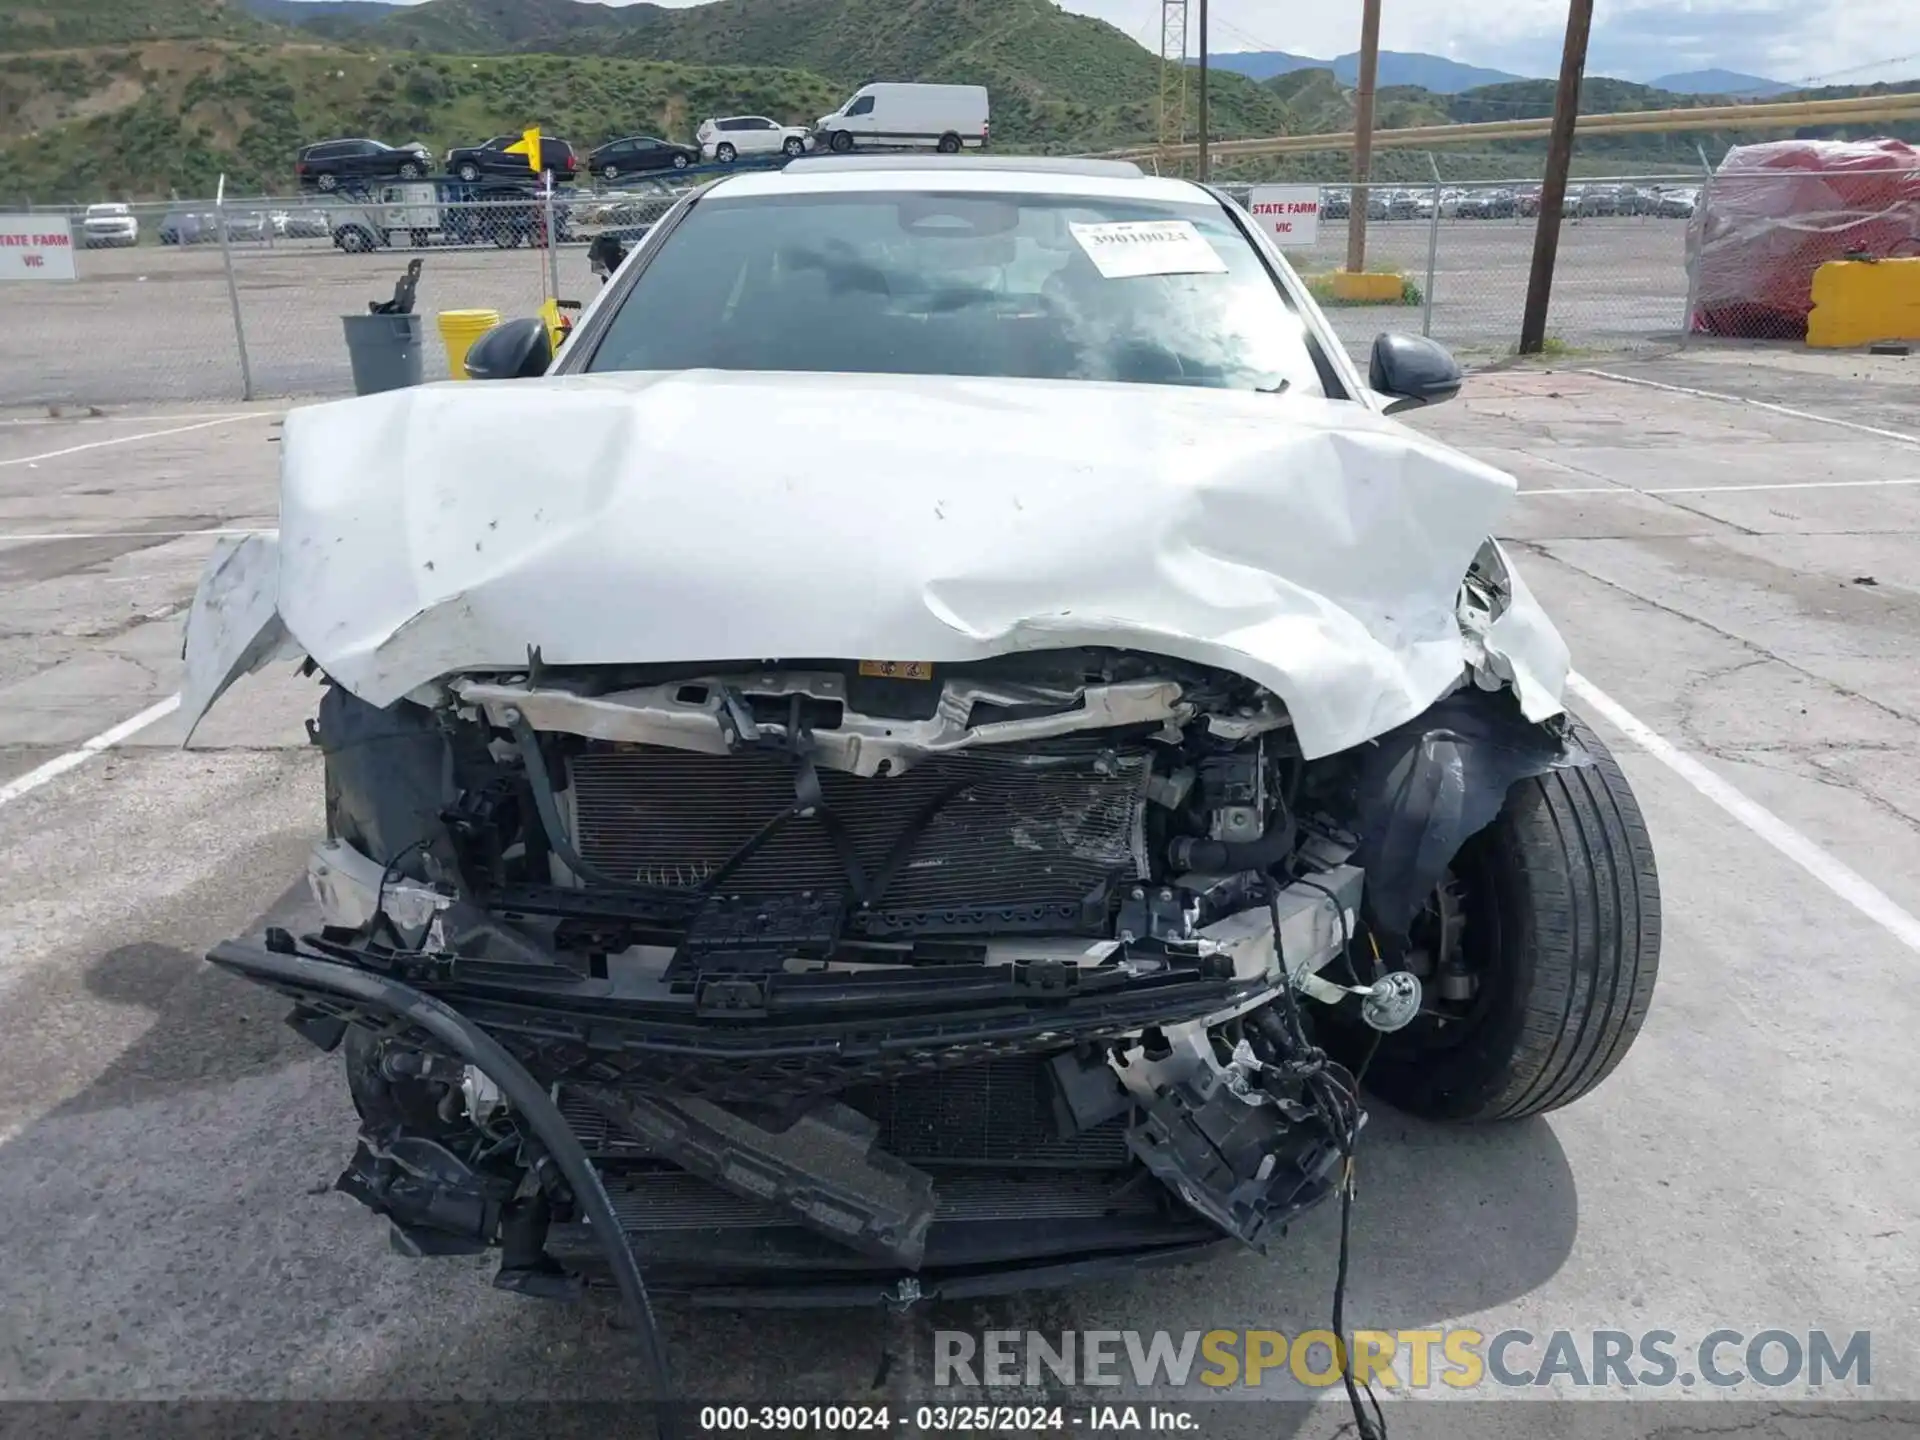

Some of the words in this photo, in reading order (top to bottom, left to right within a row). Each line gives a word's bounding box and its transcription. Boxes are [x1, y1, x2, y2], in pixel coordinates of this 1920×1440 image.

[1252, 203, 1285, 214] STATE
[1287, 202, 1317, 213] FARM
[1275, 222, 1293, 233] VIC
[0, 234, 28, 246] TATE
[32, 234, 69, 246] FARM
[23, 255, 44, 267] VIC
